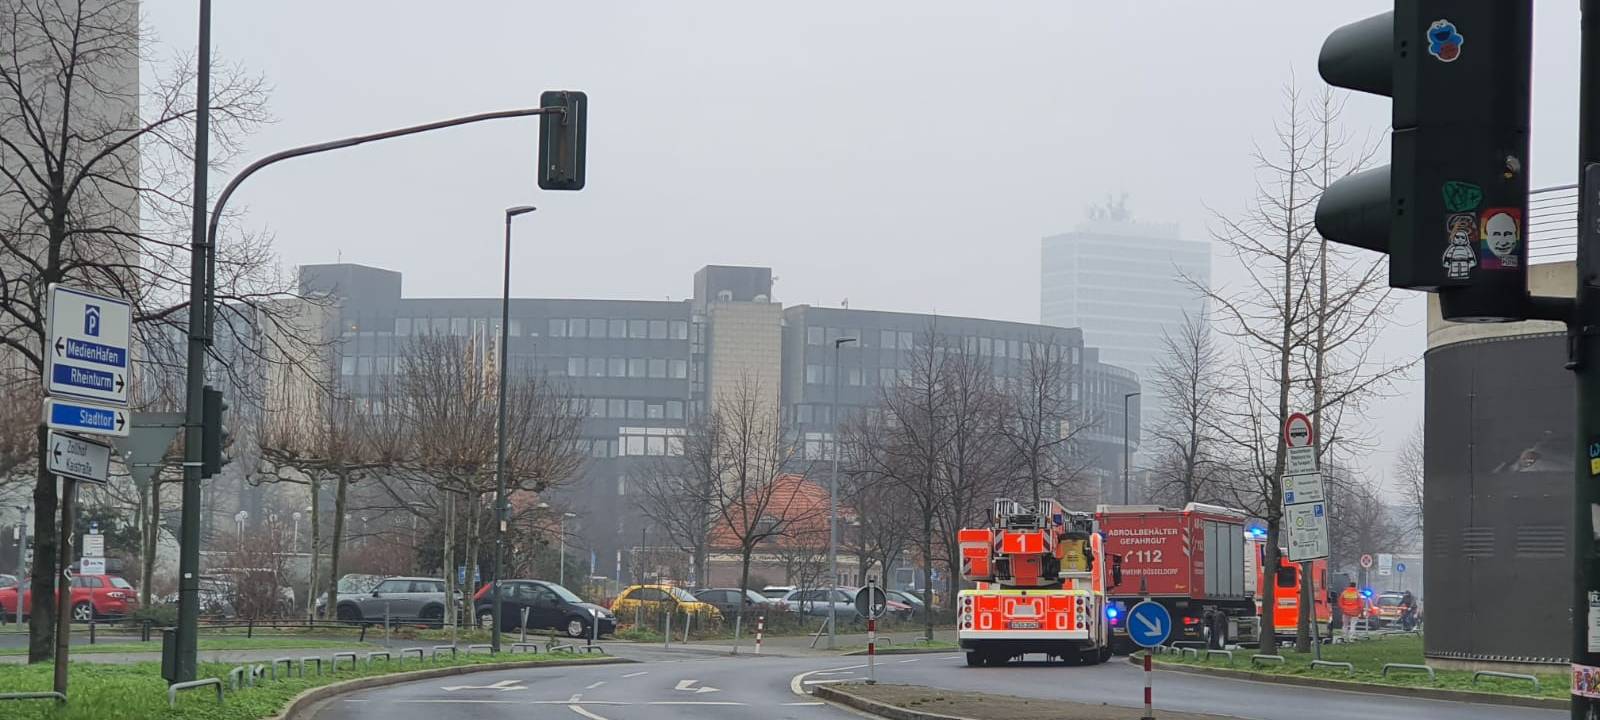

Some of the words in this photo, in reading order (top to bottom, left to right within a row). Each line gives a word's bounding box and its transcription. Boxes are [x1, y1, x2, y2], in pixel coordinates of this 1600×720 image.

[67, 341, 119, 363] MedienHafen
[71, 368, 112, 388] Rheinturm
[80, 409, 113, 427] Stadttor
[1108, 528, 1178, 537] ABROLLBEHÄLTER
[1120, 537, 1167, 546] GEFAHRGUT
[1016, 534, 1026, 553] 1
[1136, 549, 1163, 564] 112
